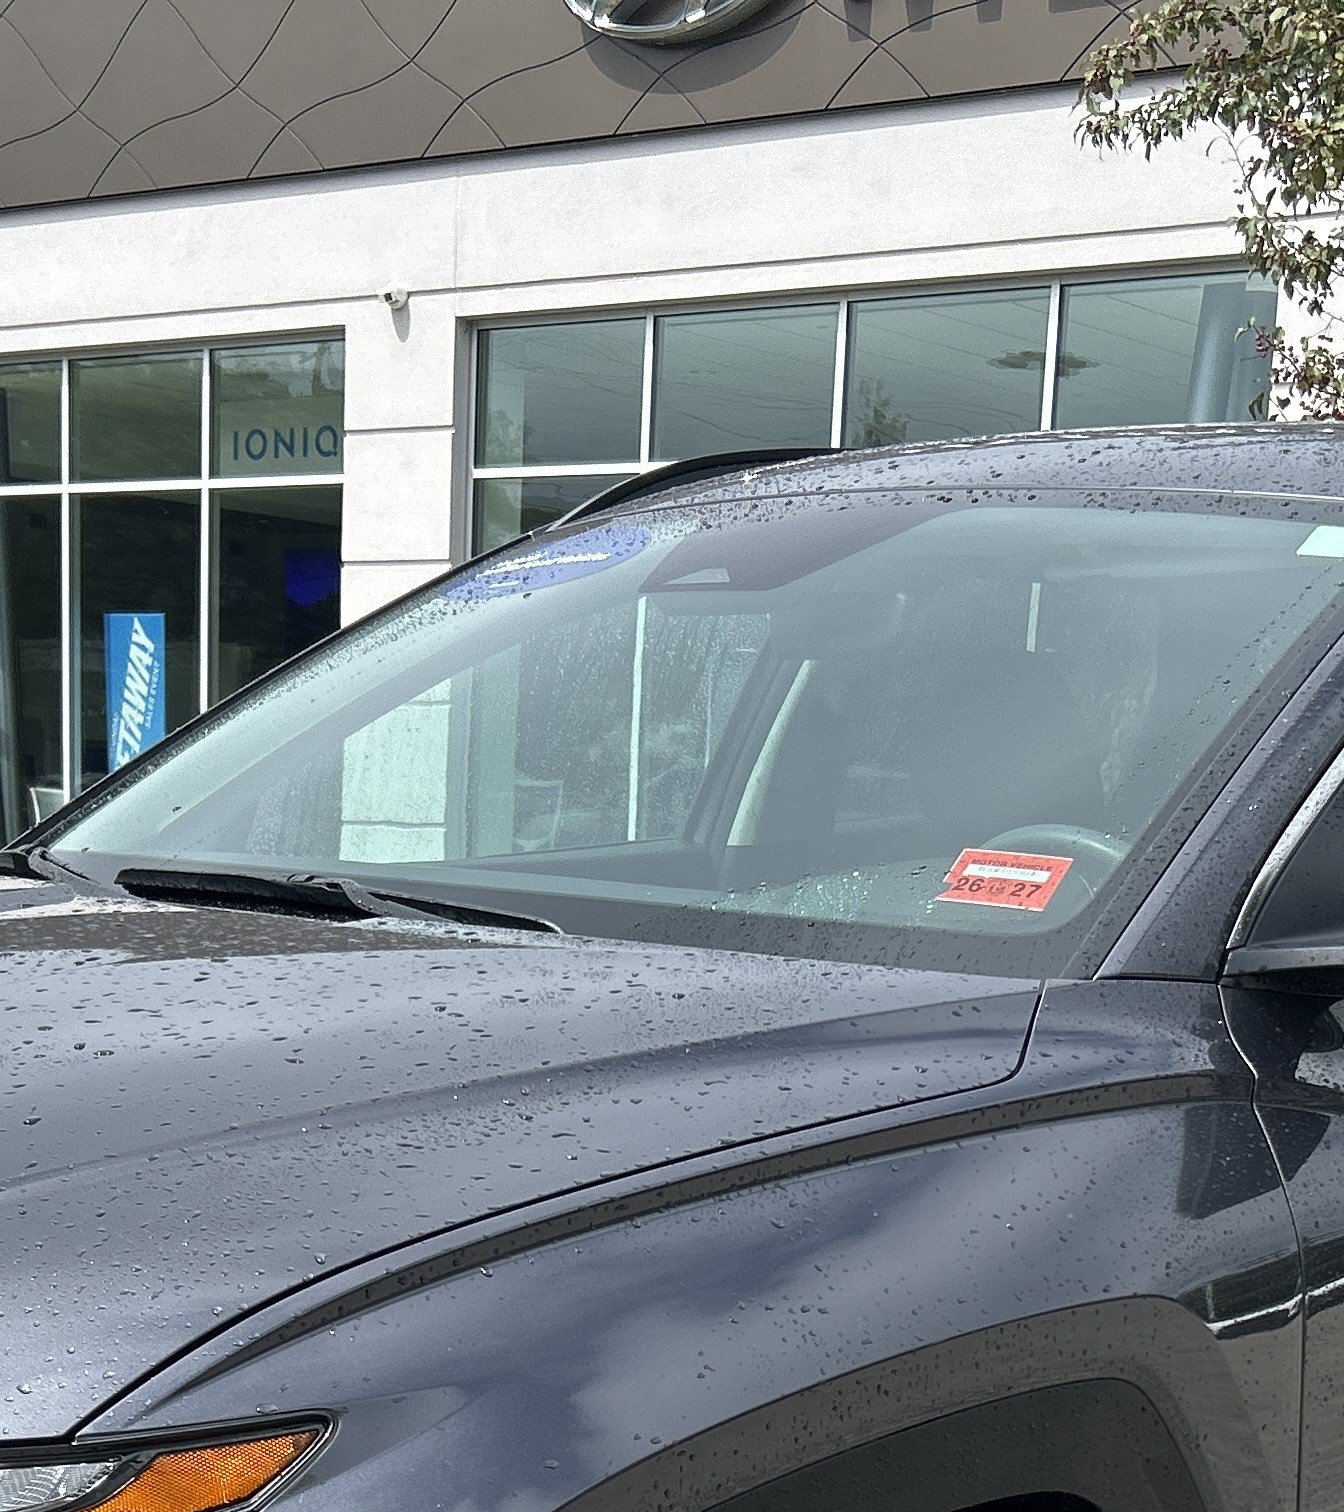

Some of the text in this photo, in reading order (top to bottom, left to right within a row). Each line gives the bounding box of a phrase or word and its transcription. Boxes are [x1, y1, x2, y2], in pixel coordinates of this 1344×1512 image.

[233, 425, 339, 461] IONIQ
[112, 616, 155, 771] ETAWAY
[971, 858, 1008, 868] MOTOR
[1009, 861, 1054, 872] VEHICLE
[951, 876, 985, 892] 26
[1009, 882, 1043, 899] 27
